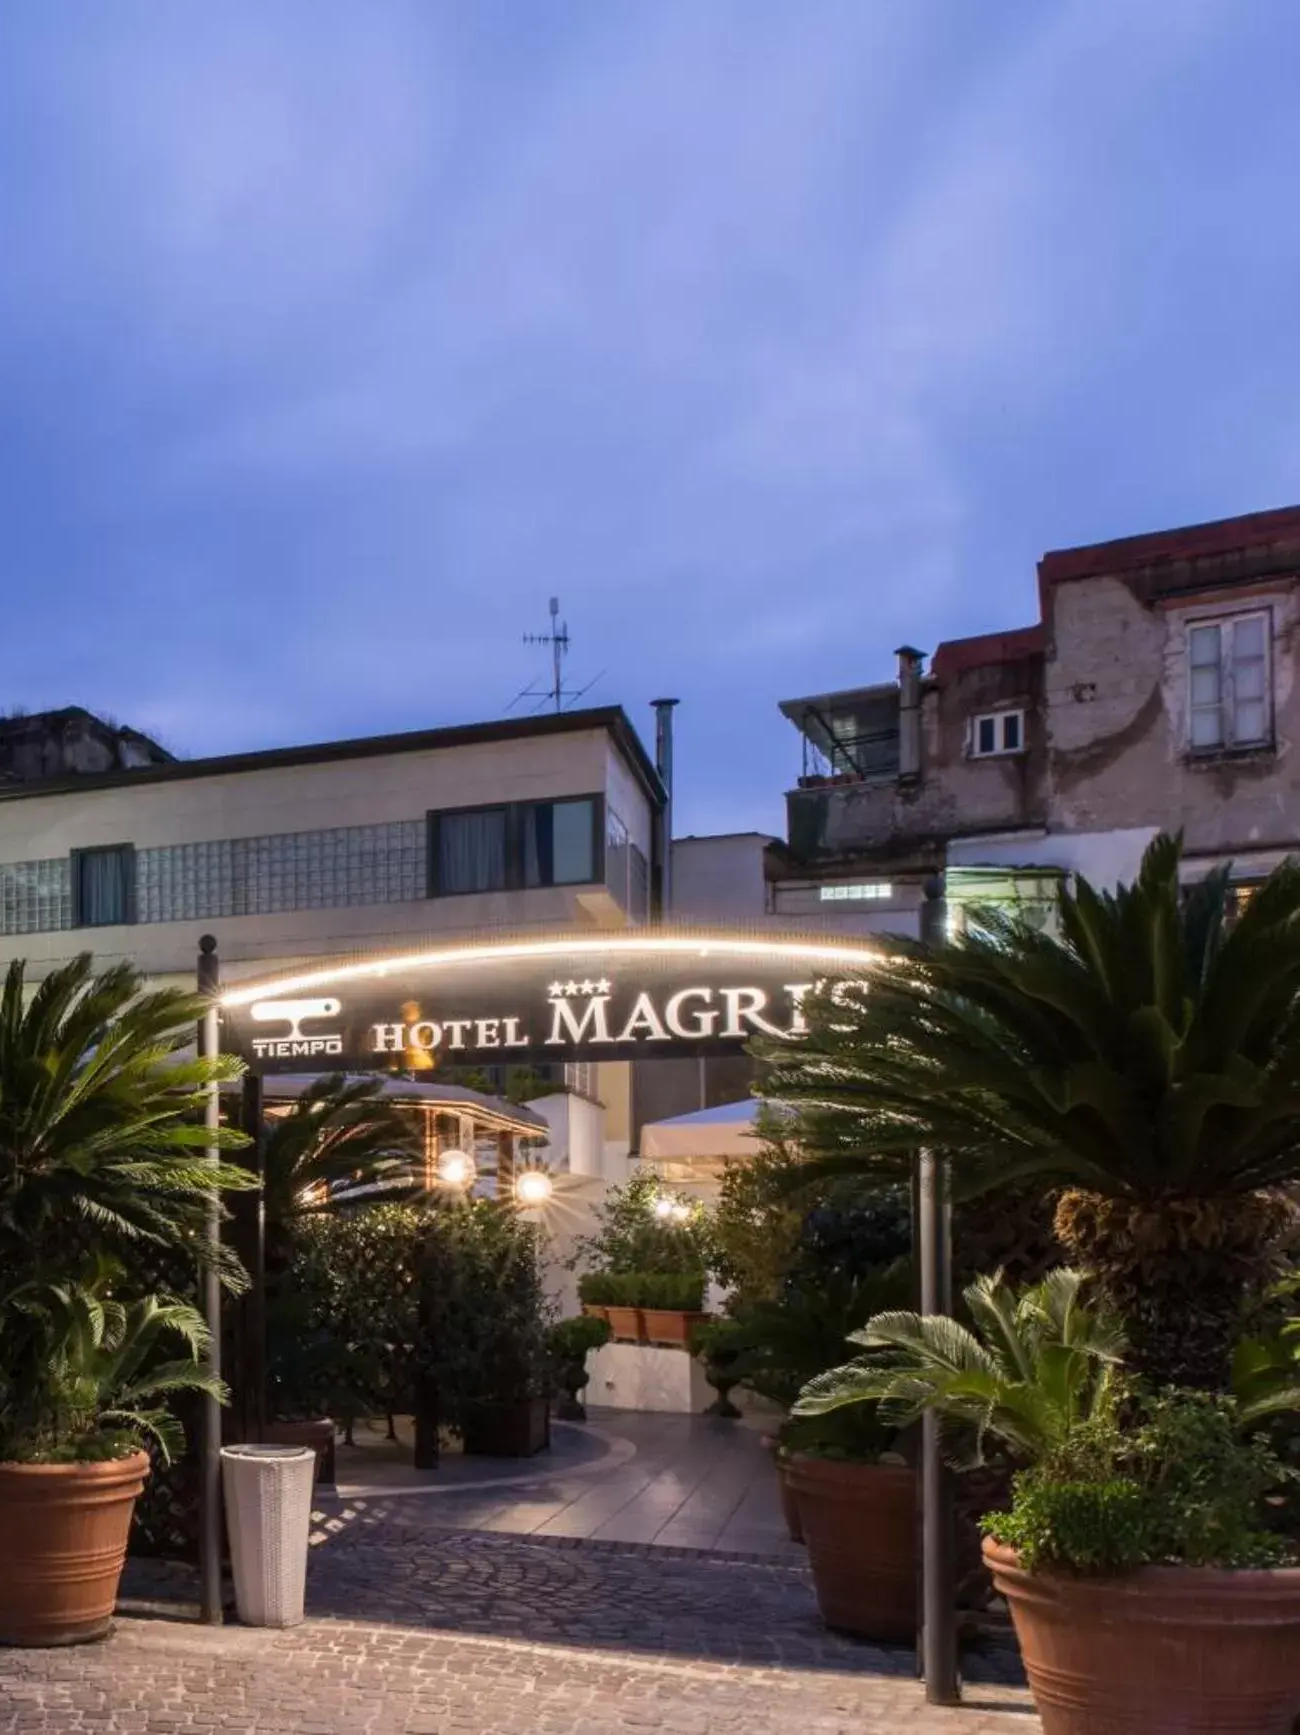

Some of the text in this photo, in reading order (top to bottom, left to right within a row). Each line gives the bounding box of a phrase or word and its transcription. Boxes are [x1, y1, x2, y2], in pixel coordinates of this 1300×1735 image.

[372, 977, 869, 1052] HOTEL MAGRI'S
[253, 1040, 342, 1058] TIEMPO
